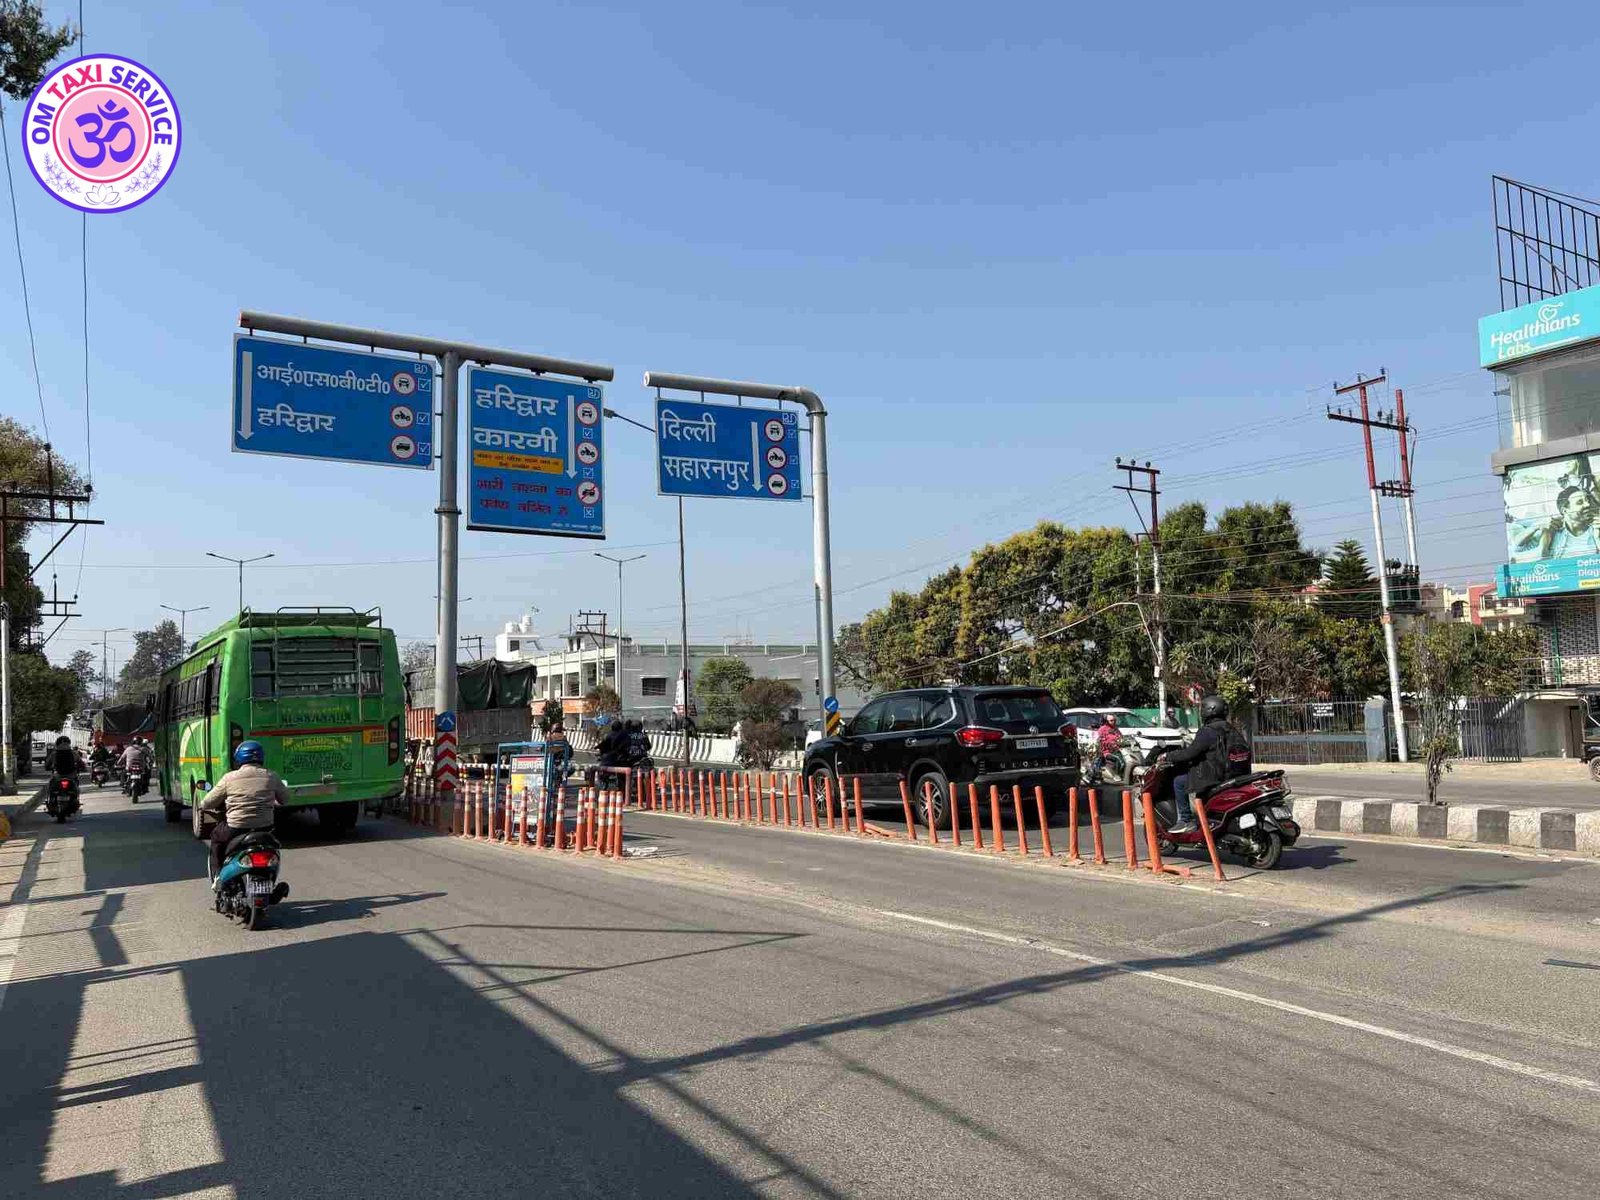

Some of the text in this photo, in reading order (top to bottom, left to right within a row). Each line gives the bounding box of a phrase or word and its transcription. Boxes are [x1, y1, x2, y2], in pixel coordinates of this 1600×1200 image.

[1490, 313, 1581, 348] Healthians
[1498, 341, 1532, 360] Labs
[474, 384, 559, 417] हरिद्वार
[256, 402, 336, 433] हरिद्वार
[660, 408, 717, 443] दिल्ली
[473, 427, 559, 453] कारगी
[662, 455, 750, 491] सहारनपुर
